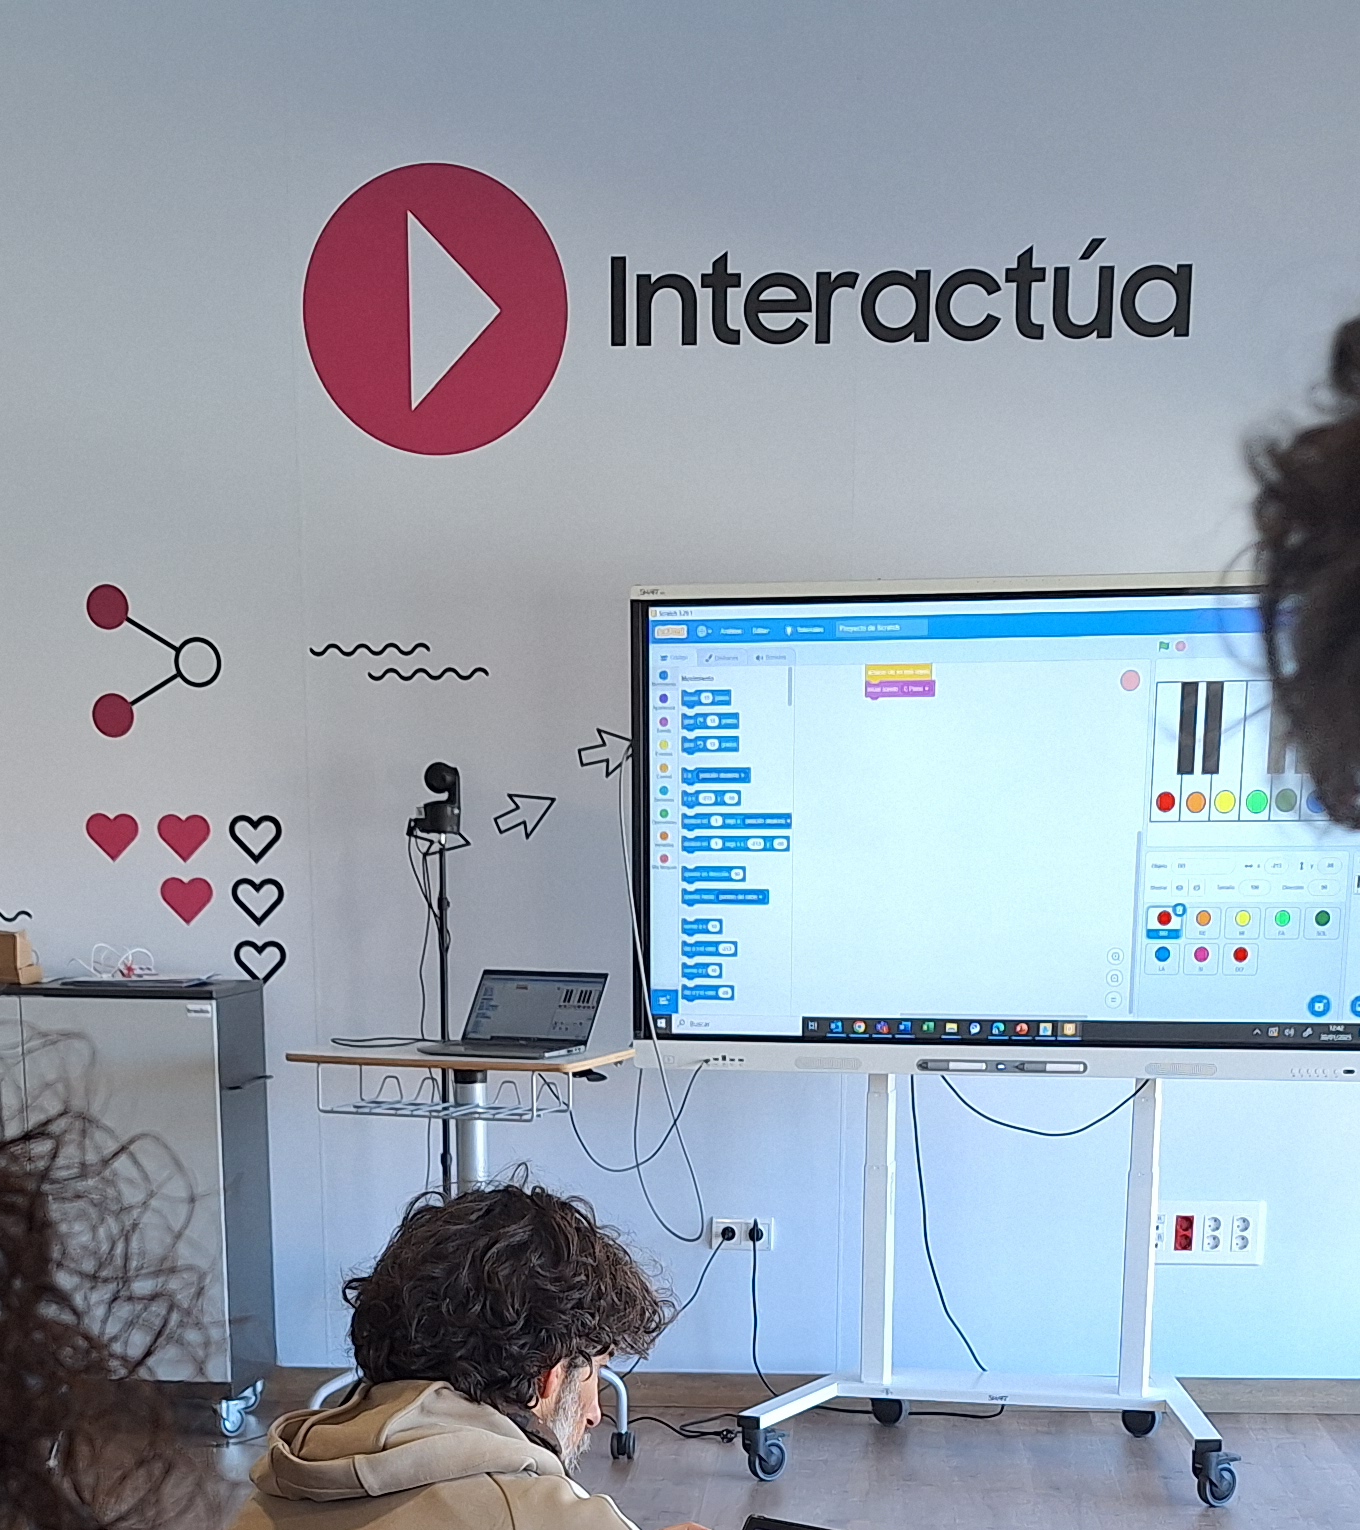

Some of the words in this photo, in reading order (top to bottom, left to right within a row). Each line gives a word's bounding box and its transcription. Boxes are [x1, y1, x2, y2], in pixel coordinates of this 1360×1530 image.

[609, 238, 1193, 347] Interactúa
[839, 624, 866, 633] Proyecto
[877, 624, 901, 632] Scratch
